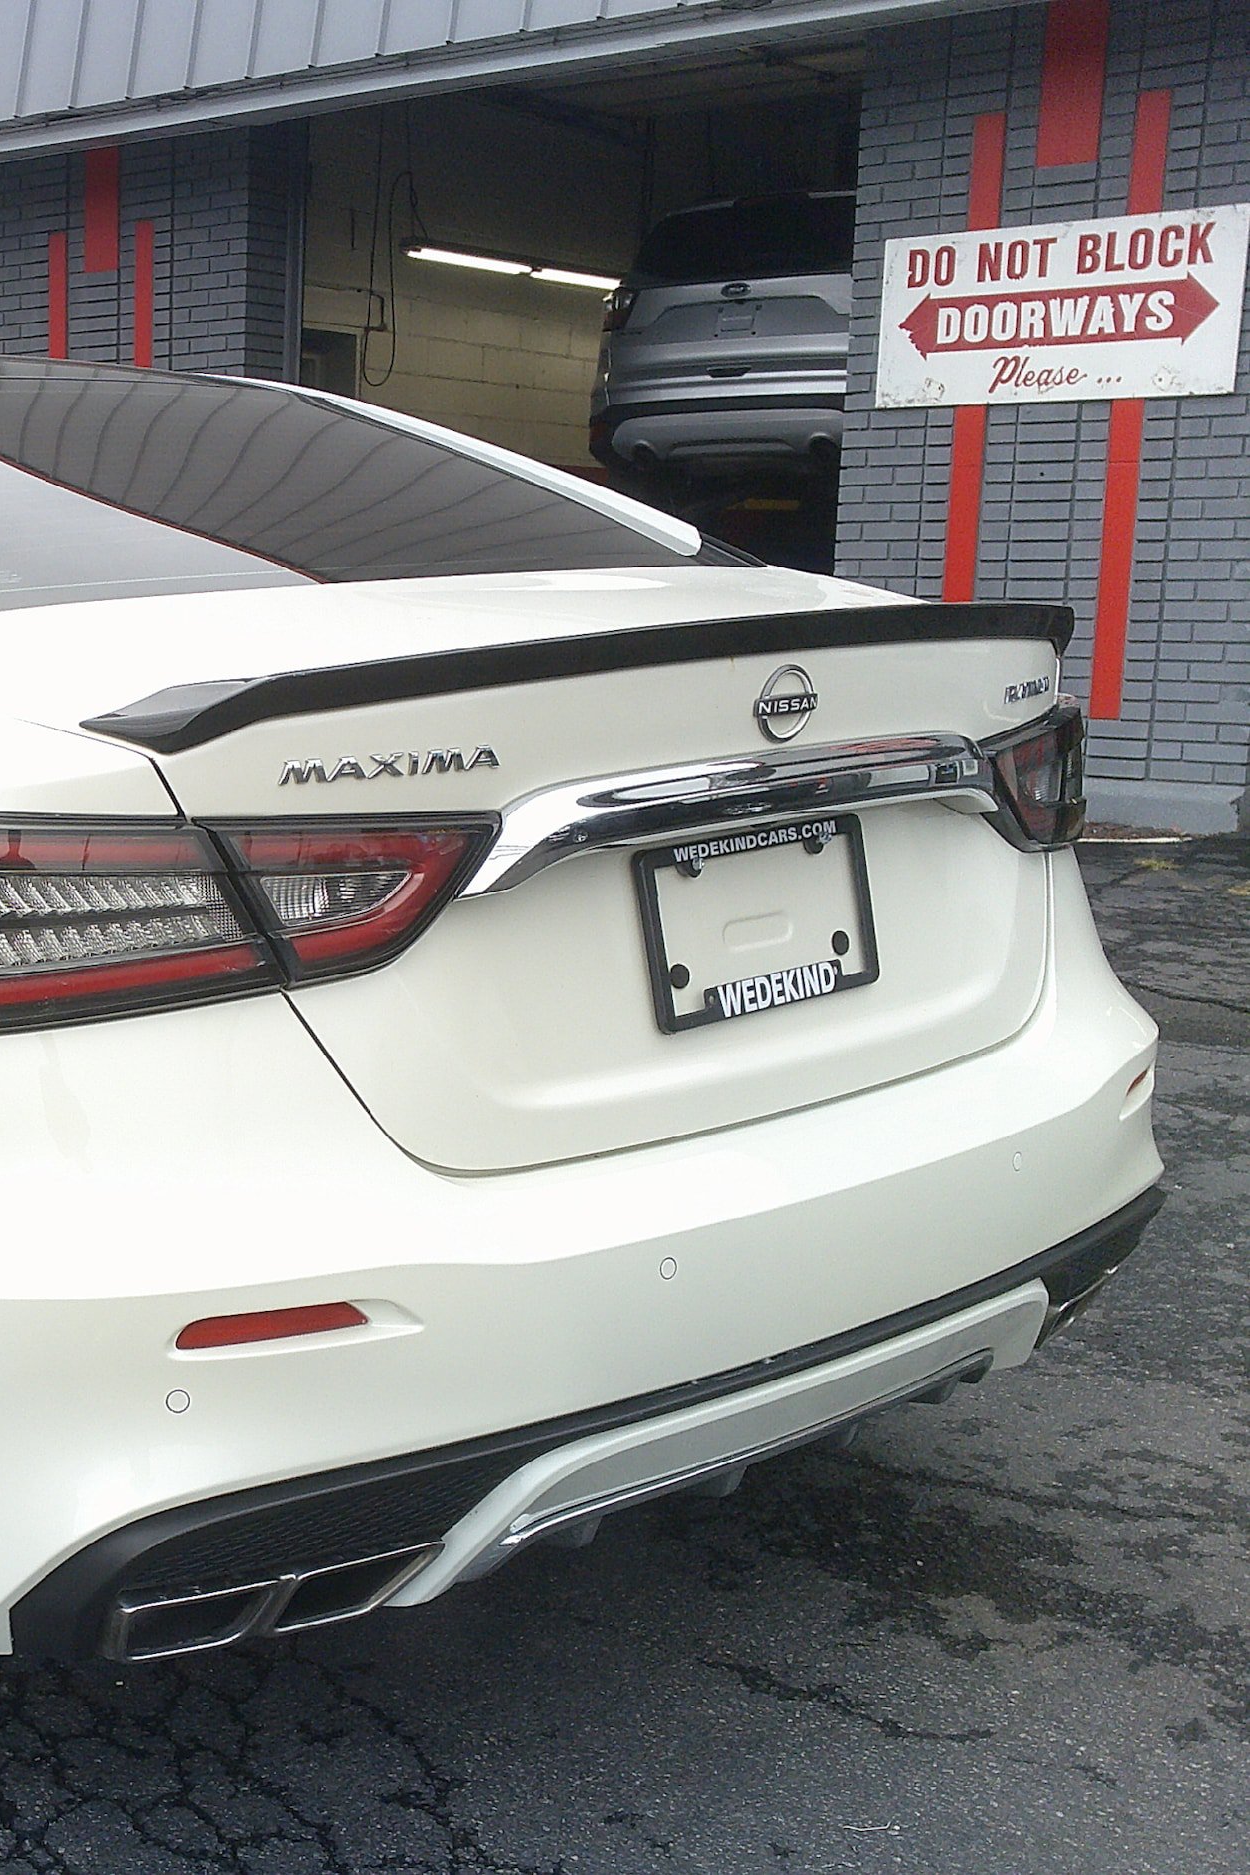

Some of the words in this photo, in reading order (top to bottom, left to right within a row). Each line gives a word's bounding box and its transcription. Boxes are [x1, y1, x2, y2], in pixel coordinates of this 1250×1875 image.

[907, 246, 956, 289] DO
[977, 237, 1058, 283] NOT
[1076, 221, 1217, 275] BLOCK
[936, 290, 1176, 346] DOORWAYS
[988, 355, 1088, 394] Please
[758, 696, 817, 715] NISSAN
[278, 744, 501, 787] MAXIMA
[673, 819, 837, 864] WEDEKINDCARS.COM
[717, 961, 836, 1018] WEDEKIND
